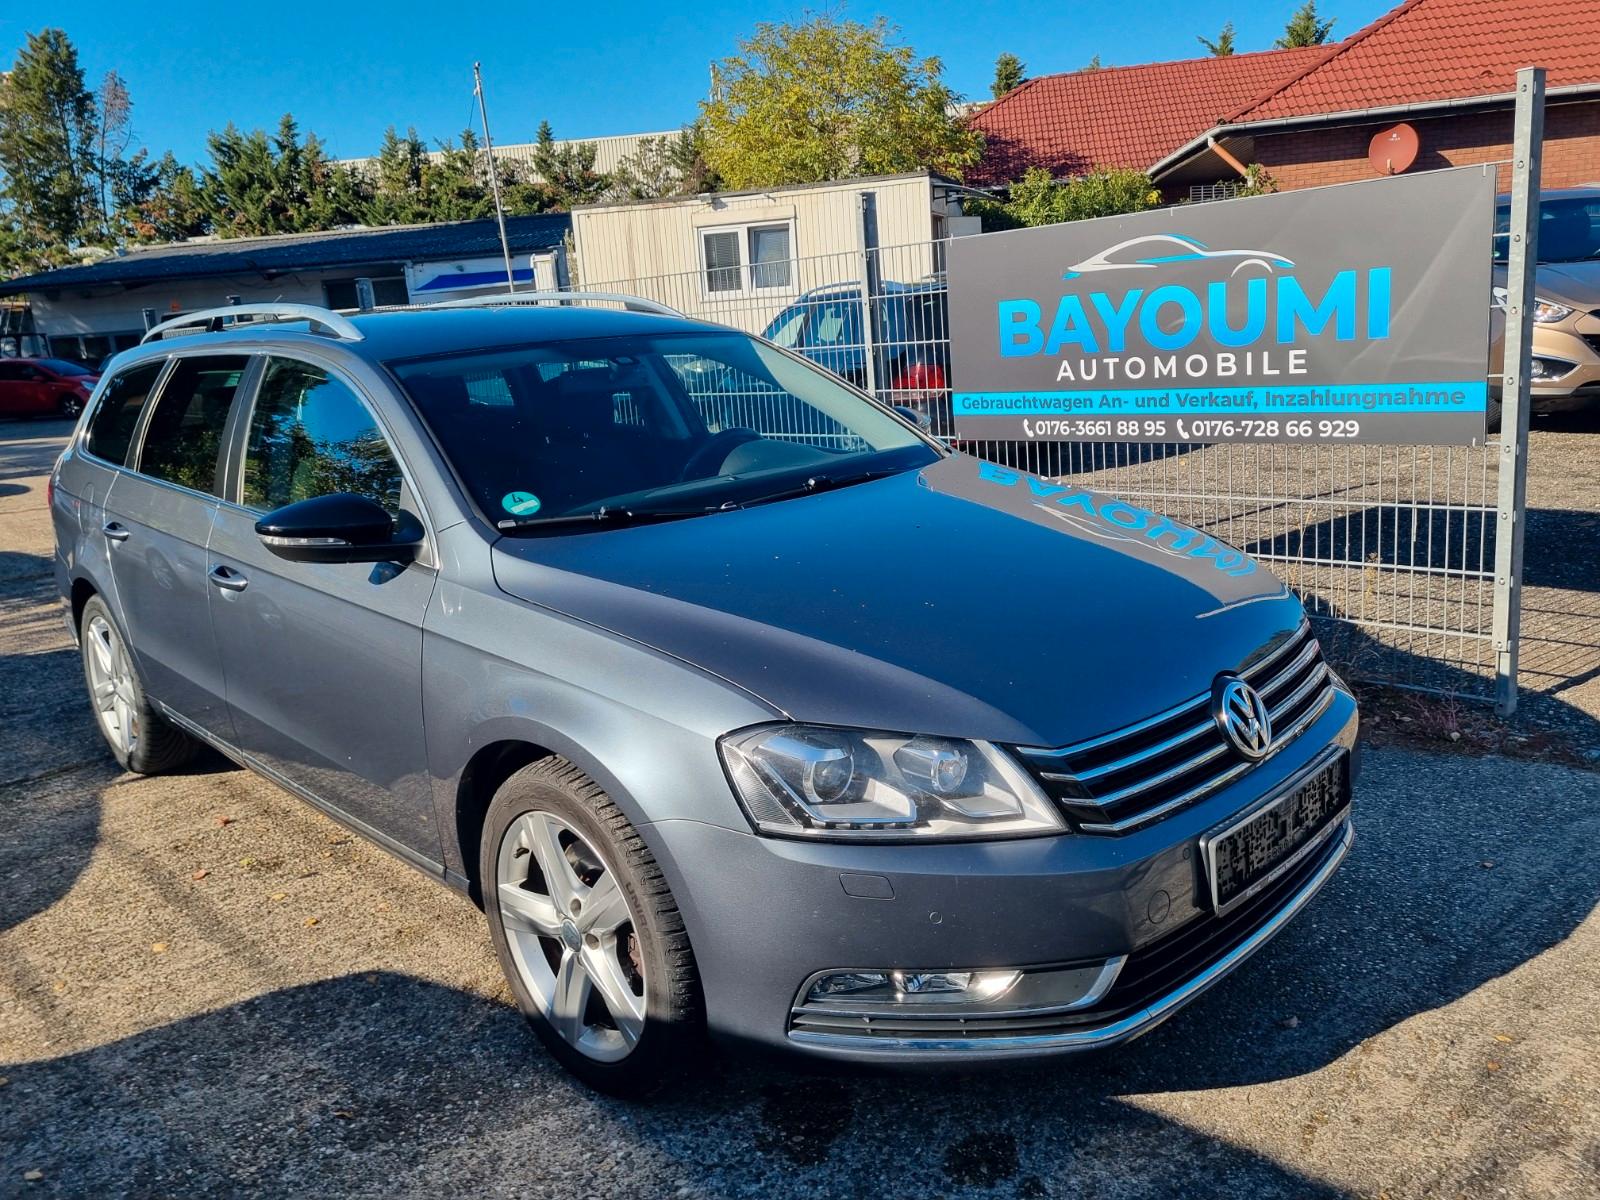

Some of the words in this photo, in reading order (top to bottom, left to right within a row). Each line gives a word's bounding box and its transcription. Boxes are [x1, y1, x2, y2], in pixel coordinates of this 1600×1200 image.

[998, 266, 1393, 359] BAYOUMI
[1056, 349, 1308, 382] AUTOMOBILE
[961, 395, 1094, 413] Gebrauchtwagen
[1098, 396, 1129, 409] An-
[1134, 392, 1170, 409] und
[1175, 390, 1259, 410] Verkauf,
[1264, 387, 1467, 411] Inzahlungnahme
[1035, 419, 1112, 437] 0176-3661
[1116, 420, 1140, 437] 88
[1143, 420, 1167, 437] 95
[1190, 419, 1280, 438] 0176-728
[1285, 419, 1313, 438] 66
[1318, 419, 1361, 438] 929
